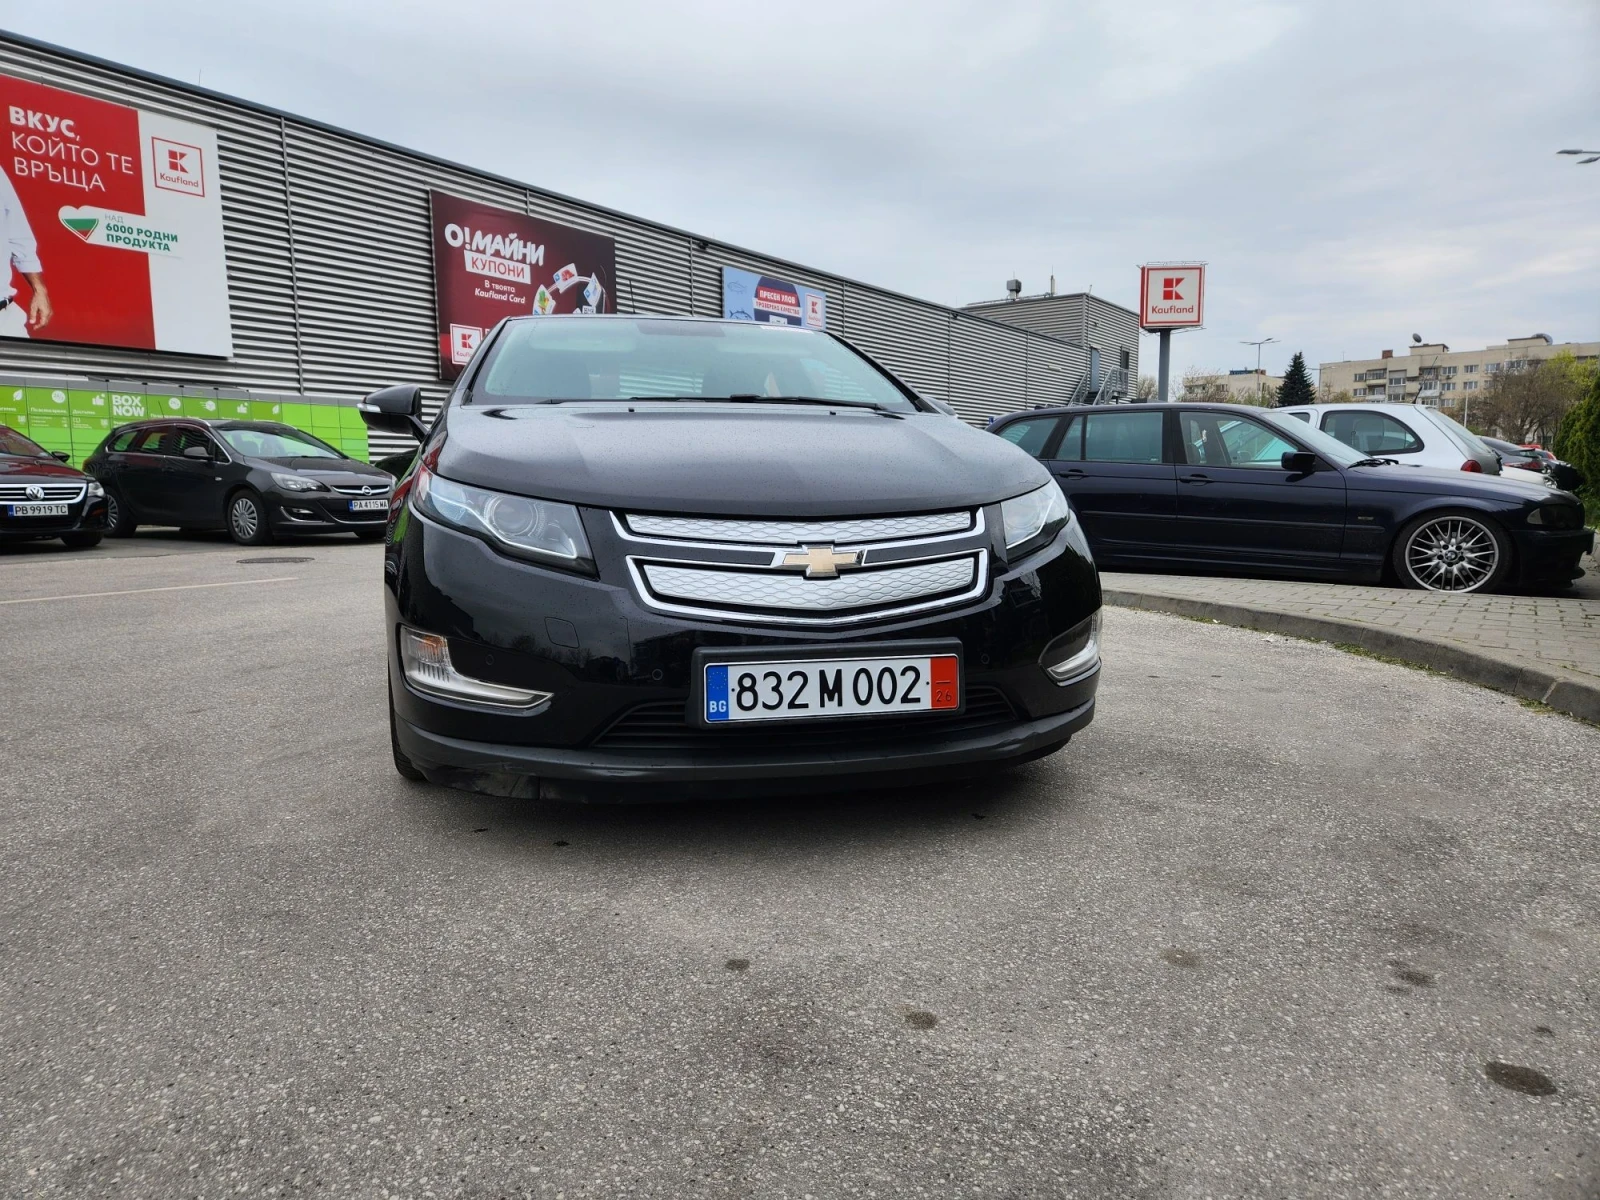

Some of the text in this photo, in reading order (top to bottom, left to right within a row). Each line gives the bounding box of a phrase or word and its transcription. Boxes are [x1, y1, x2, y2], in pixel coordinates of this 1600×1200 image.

[9, 105, 81, 141] ВКУС,
[12, 131, 135, 174] КОЙТО ТЕ
[14, 157, 106, 192] ВРЪЩА
[160, 173, 199, 188] Kaufland
[104, 214, 124, 224] НАД
[106, 223, 179, 242] 6000 РОДНИ
[106, 233, 171, 252] ПРОДУКТА
[471, 256, 525, 279] КУПОНИ
[485, 280, 516, 293] В твоята
[474, 288, 526, 304] Kaufland Card
[1151, 305, 1194, 314] Kaufland
[112, 395, 142, 406] BOX
[113, 406, 145, 417] NOW
[15, 505, 67, 515] PB 9919 TC
[709, 665, 921, 713] BG 832 M 002
